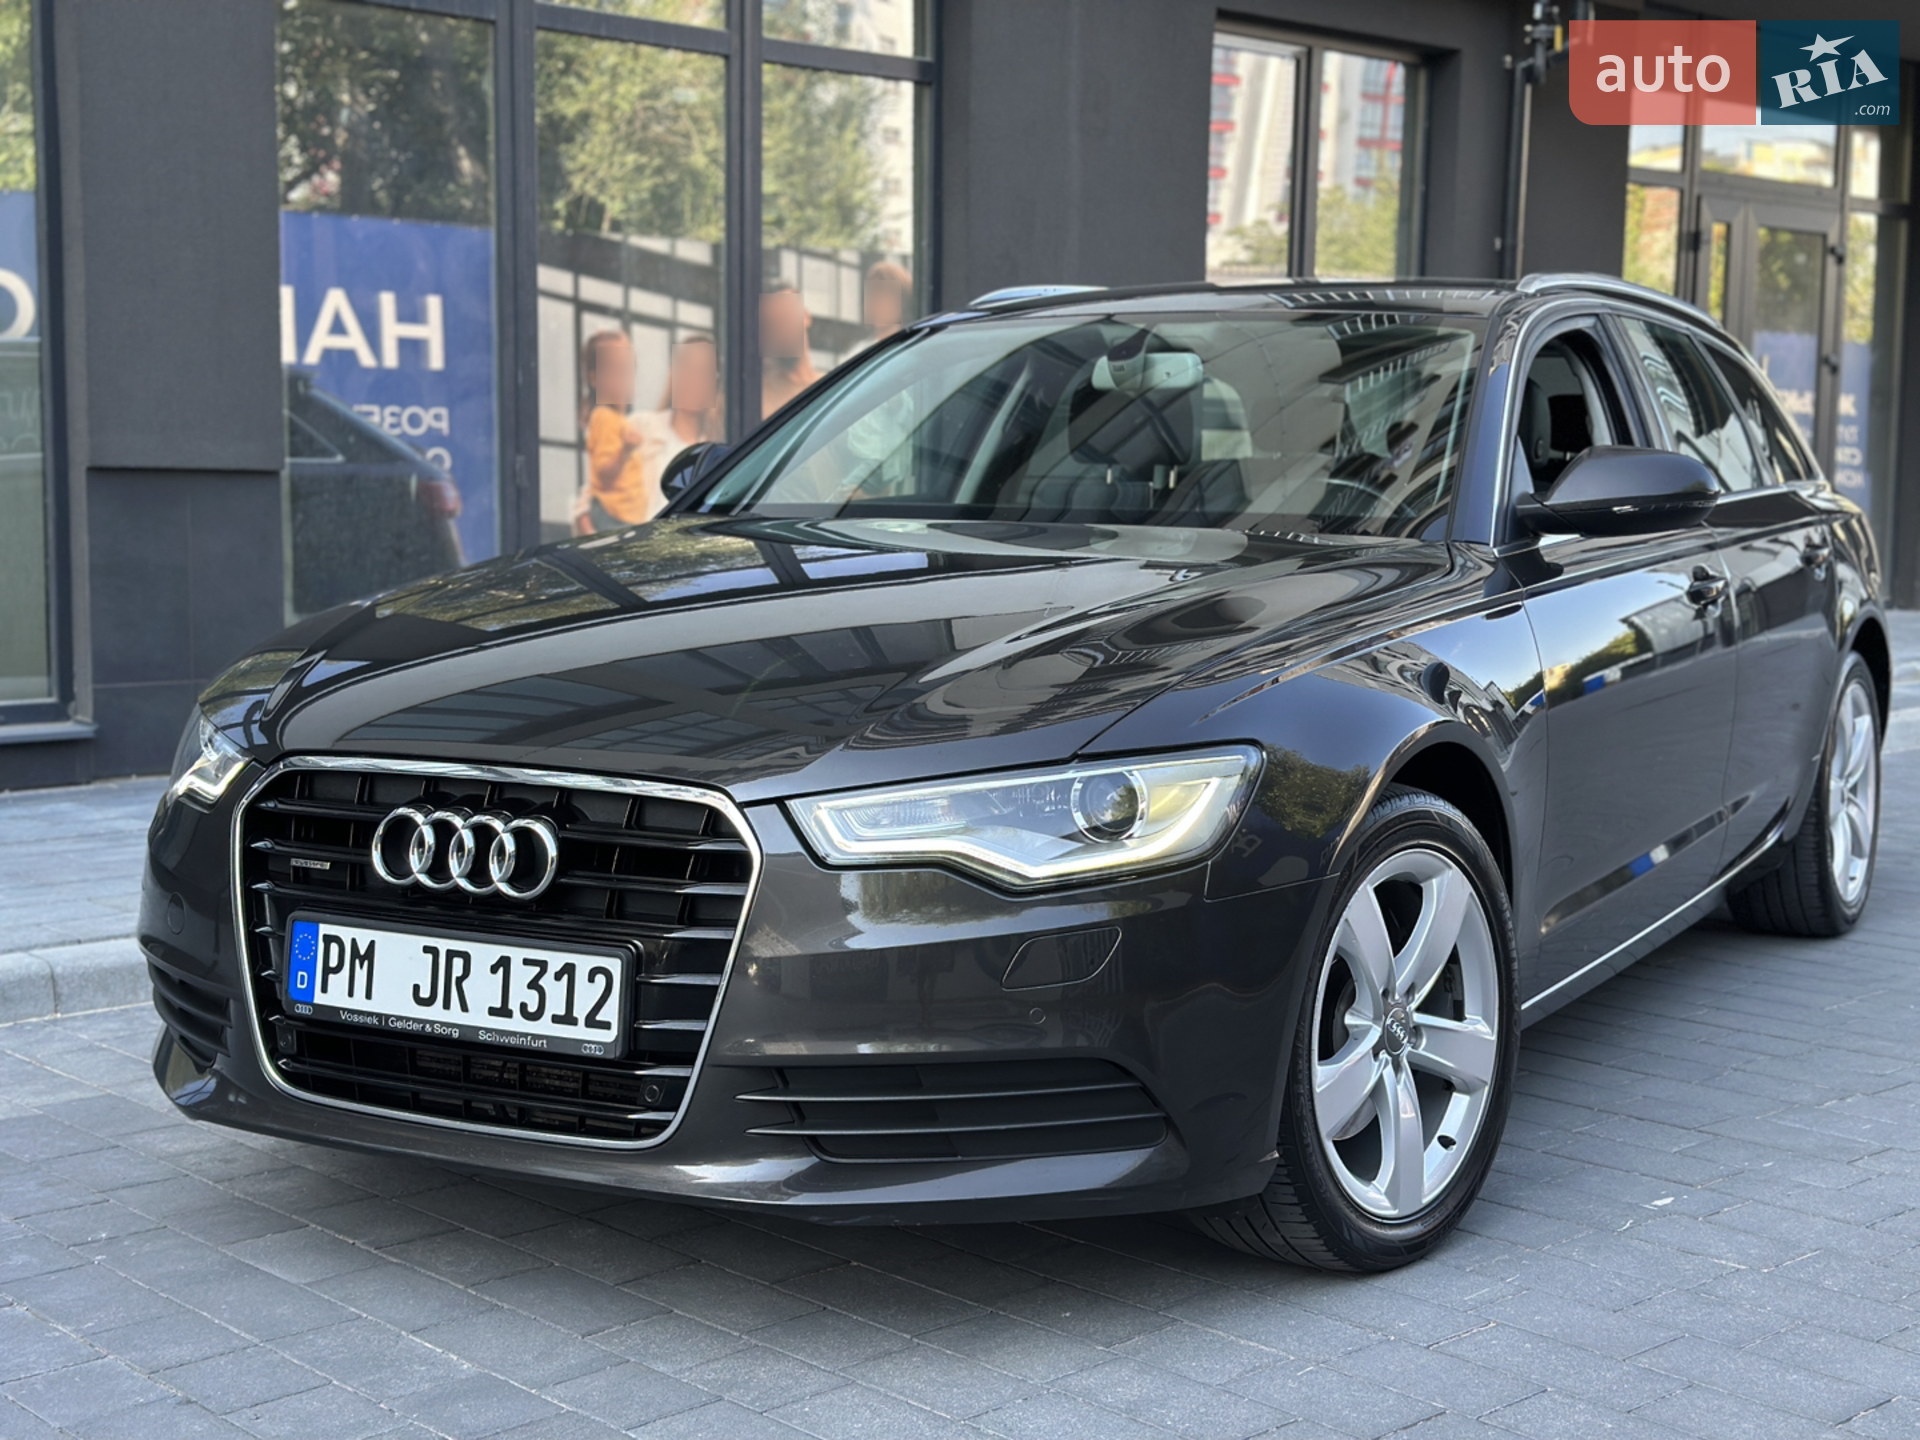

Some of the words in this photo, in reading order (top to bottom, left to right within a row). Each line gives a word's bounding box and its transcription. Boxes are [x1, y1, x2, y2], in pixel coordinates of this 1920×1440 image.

[296, 971, 308, 989] D
[320, 933, 376, 1001] PM
[412, 944, 472, 1013] JR
[487, 954, 614, 1031] 1312
[339, 1010, 379, 1026] Vossiek
[388, 1016, 423, 1032] Gelder
[425, 1023, 433, 1033] &
[433, 1023, 460, 1038] Sorg
[478, 1029, 548, 1049] Schweinfurt
